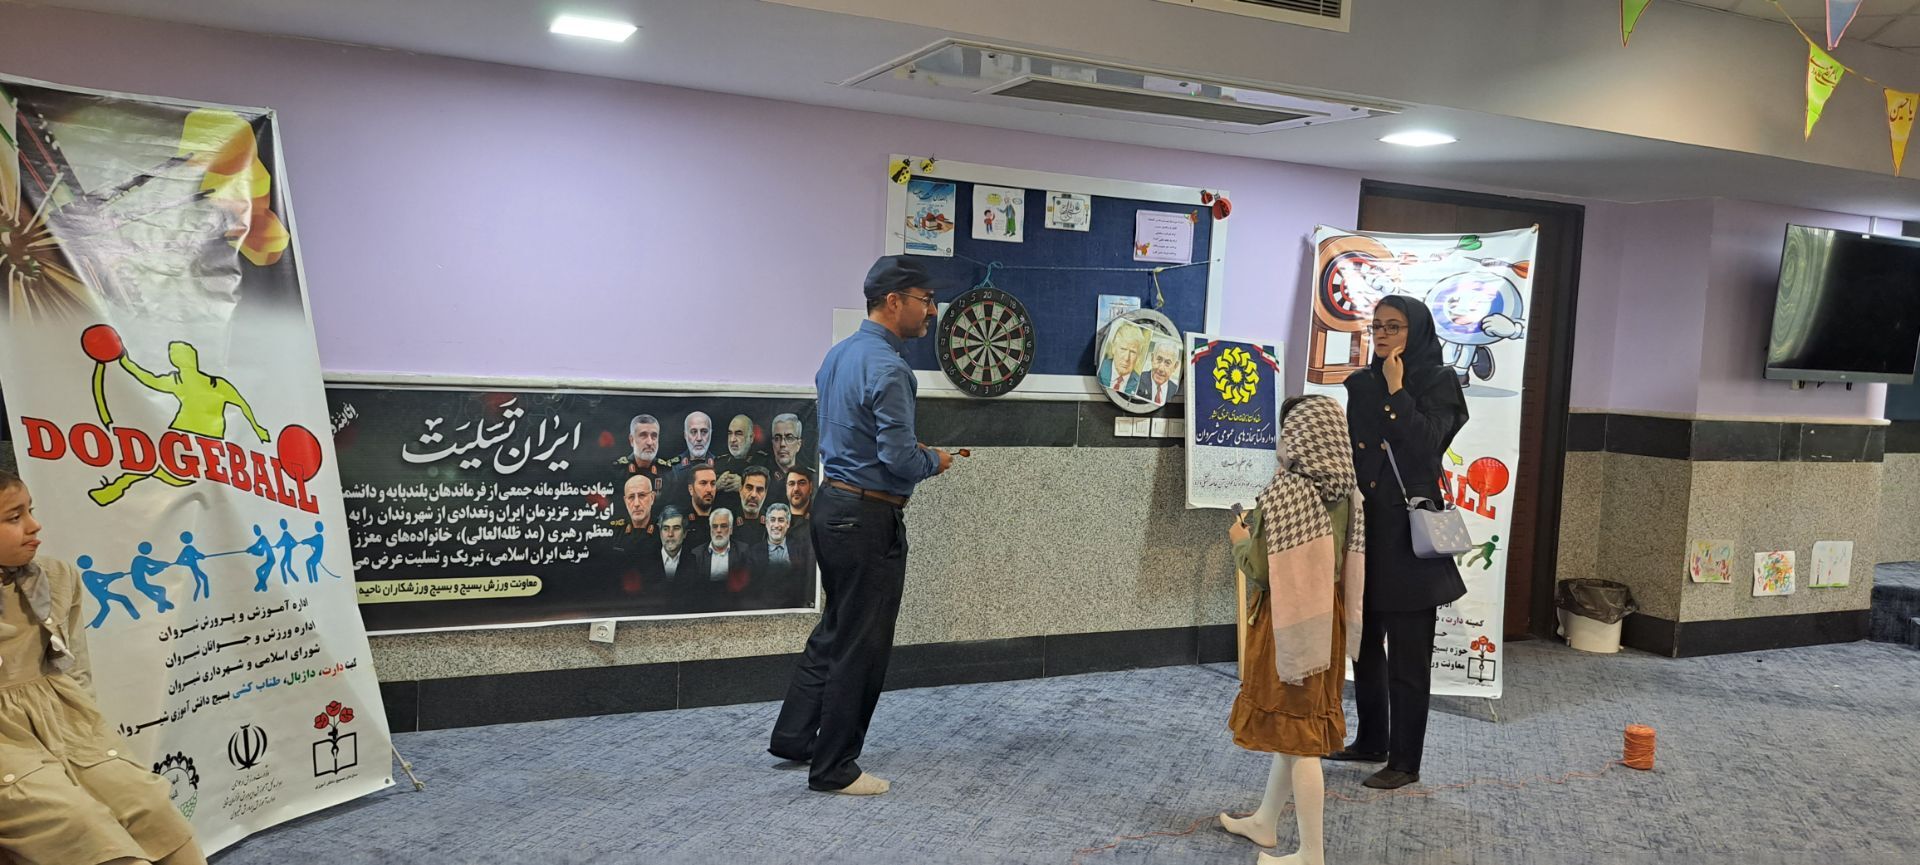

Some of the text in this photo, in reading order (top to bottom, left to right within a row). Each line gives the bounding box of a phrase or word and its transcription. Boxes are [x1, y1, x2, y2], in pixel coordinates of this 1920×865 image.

[983, 291, 992, 299] 20
[1196, 422, 1219, 445] شیروان
[1217, 428, 1234, 444] عمومی
[493, 414, 582, 475] ایران
[21, 416, 320, 515] DODGEBALL
[342, 483, 376, 498] دانشم
[378, 488, 385, 503] و
[428, 482, 486, 502] فرماندهان
[487, 482, 498, 500] از
[498, 484, 532, 501] جمعی
[533, 482, 579, 500] مظلومانه
[580, 482, 614, 497] شهادت
[348, 509, 360, 525] به
[362, 506, 374, 528] را
[377, 505, 434, 525] شهروندان
[434, 505, 446, 524] از
[496, 503, 525, 523] ایران
[525, 503, 569, 524] عزیزمان
[571, 502, 598, 521] کشور
[354, 531, 382, 548] معزز
[547, 528, 583, 543] رهبری
[585, 523, 614, 541] معظم
[371, 551, 403, 570] عرض
[405, 550, 440, 567] تسلیت
[441, 554, 448, 567] و
[450, 548, 484, 567] تبریک
[530, 545, 558, 565] ایران
[560, 545, 590, 563] شریف
[359, 584, 381, 597] ناحیه
[382, 581, 428, 596] ورزشکاران
[429, 583, 452, 597] بسیج
[460, 582, 482, 596] بسیج
[483, 579, 509, 592] ورزش
[510, 578, 538, 590] معاونت
[247, 599, 290, 621] آموزش
[292, 597, 309, 612] اداره
[200, 612, 236, 631] پرورش
[238, 612, 245, 623] و
[1465, 618, 1485, 629] کمیته
[262, 628, 292, 643] ورزش
[294, 620, 316, 636] اداره
[202, 635, 252, 657] جوانان
[254, 635, 260, 645] و
[255, 649, 289, 669] اسلامی
[290, 643, 321, 661] شورای
[1450, 647, 1468, 656] حوزه
[202, 659, 244, 683] شهرداری
[246, 661, 252, 671] و
[1441, 660, 1465, 670] معاونت
[232, 681, 253, 699] کشی
[255, 676, 281, 692] طناب
[191, 695, 210, 713] دانش
[211, 690, 231, 706] بسیج
